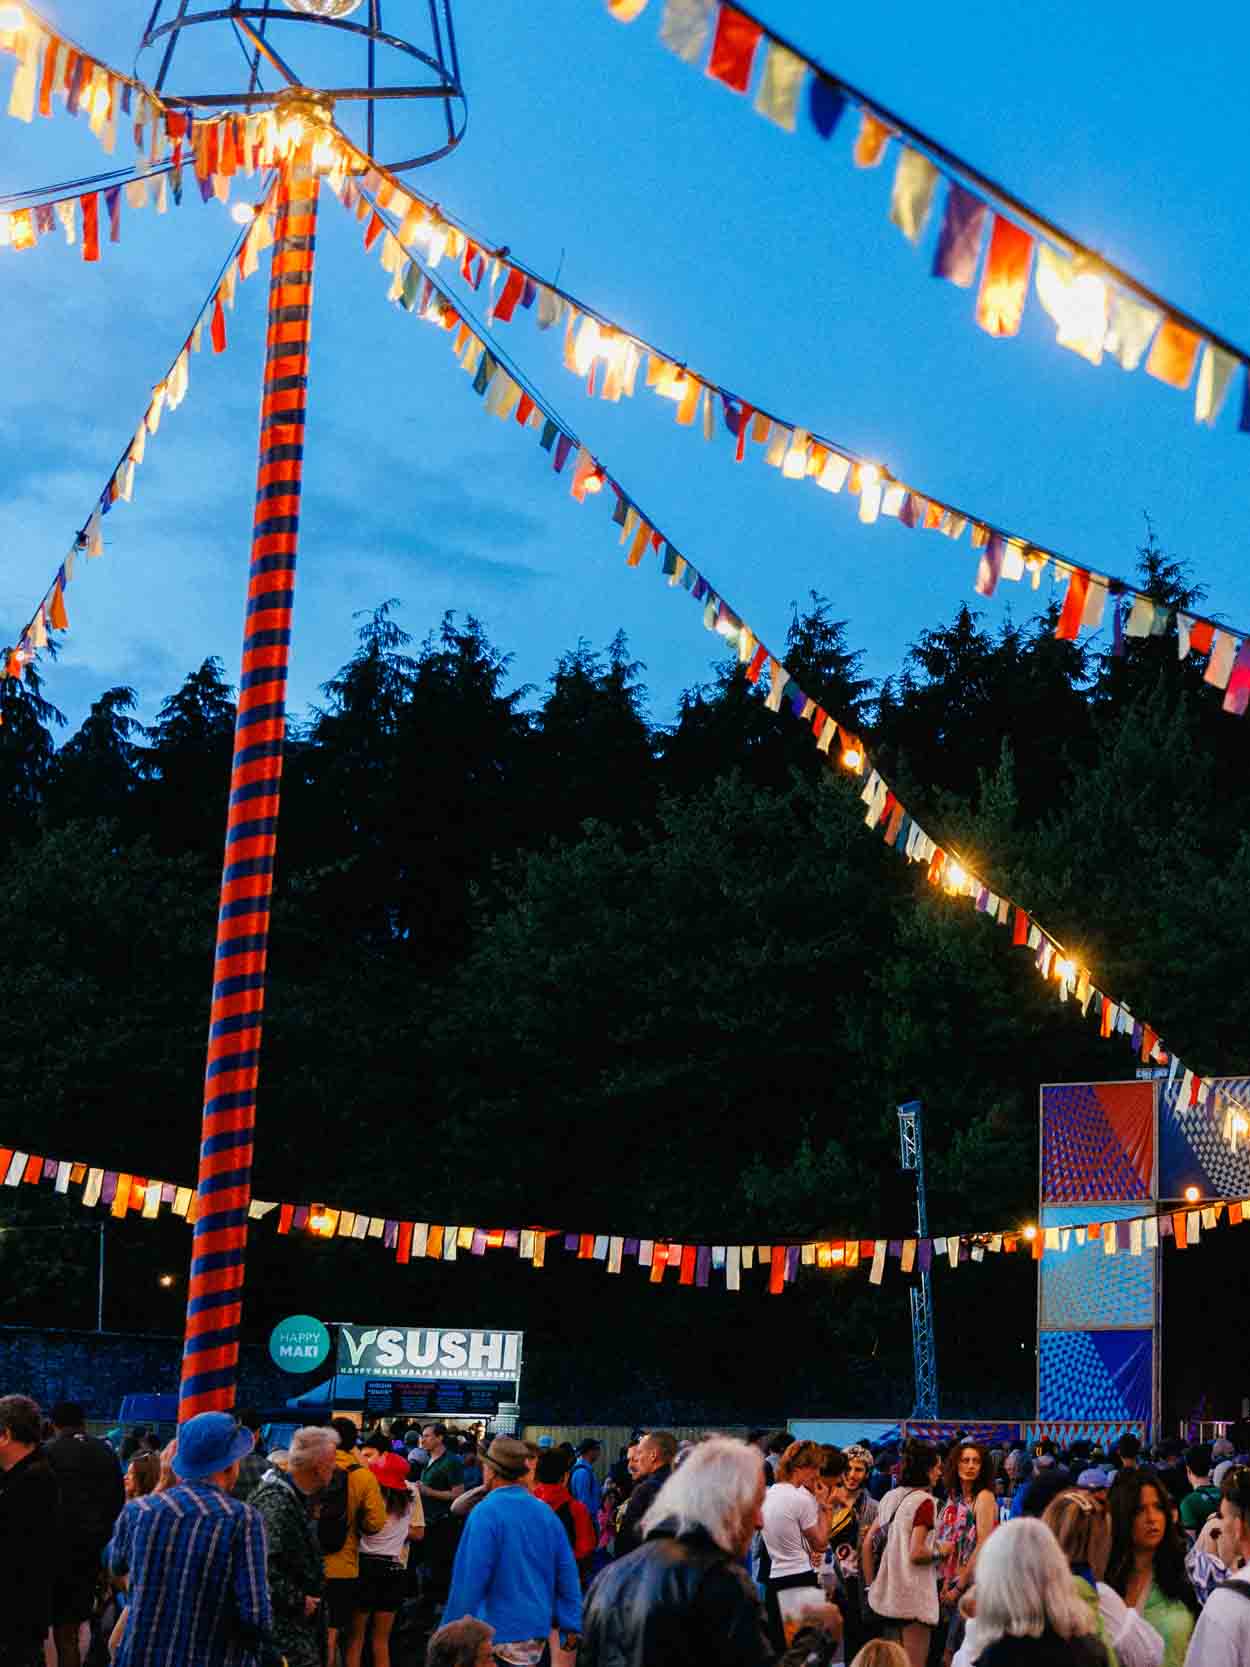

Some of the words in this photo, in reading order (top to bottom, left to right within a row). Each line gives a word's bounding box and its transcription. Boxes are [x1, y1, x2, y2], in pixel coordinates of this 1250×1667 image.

[280, 1331, 320, 1343] HAPPY
[280, 1345, 319, 1357] MAKI
[340, 1367, 371, 1375] HAPPY
